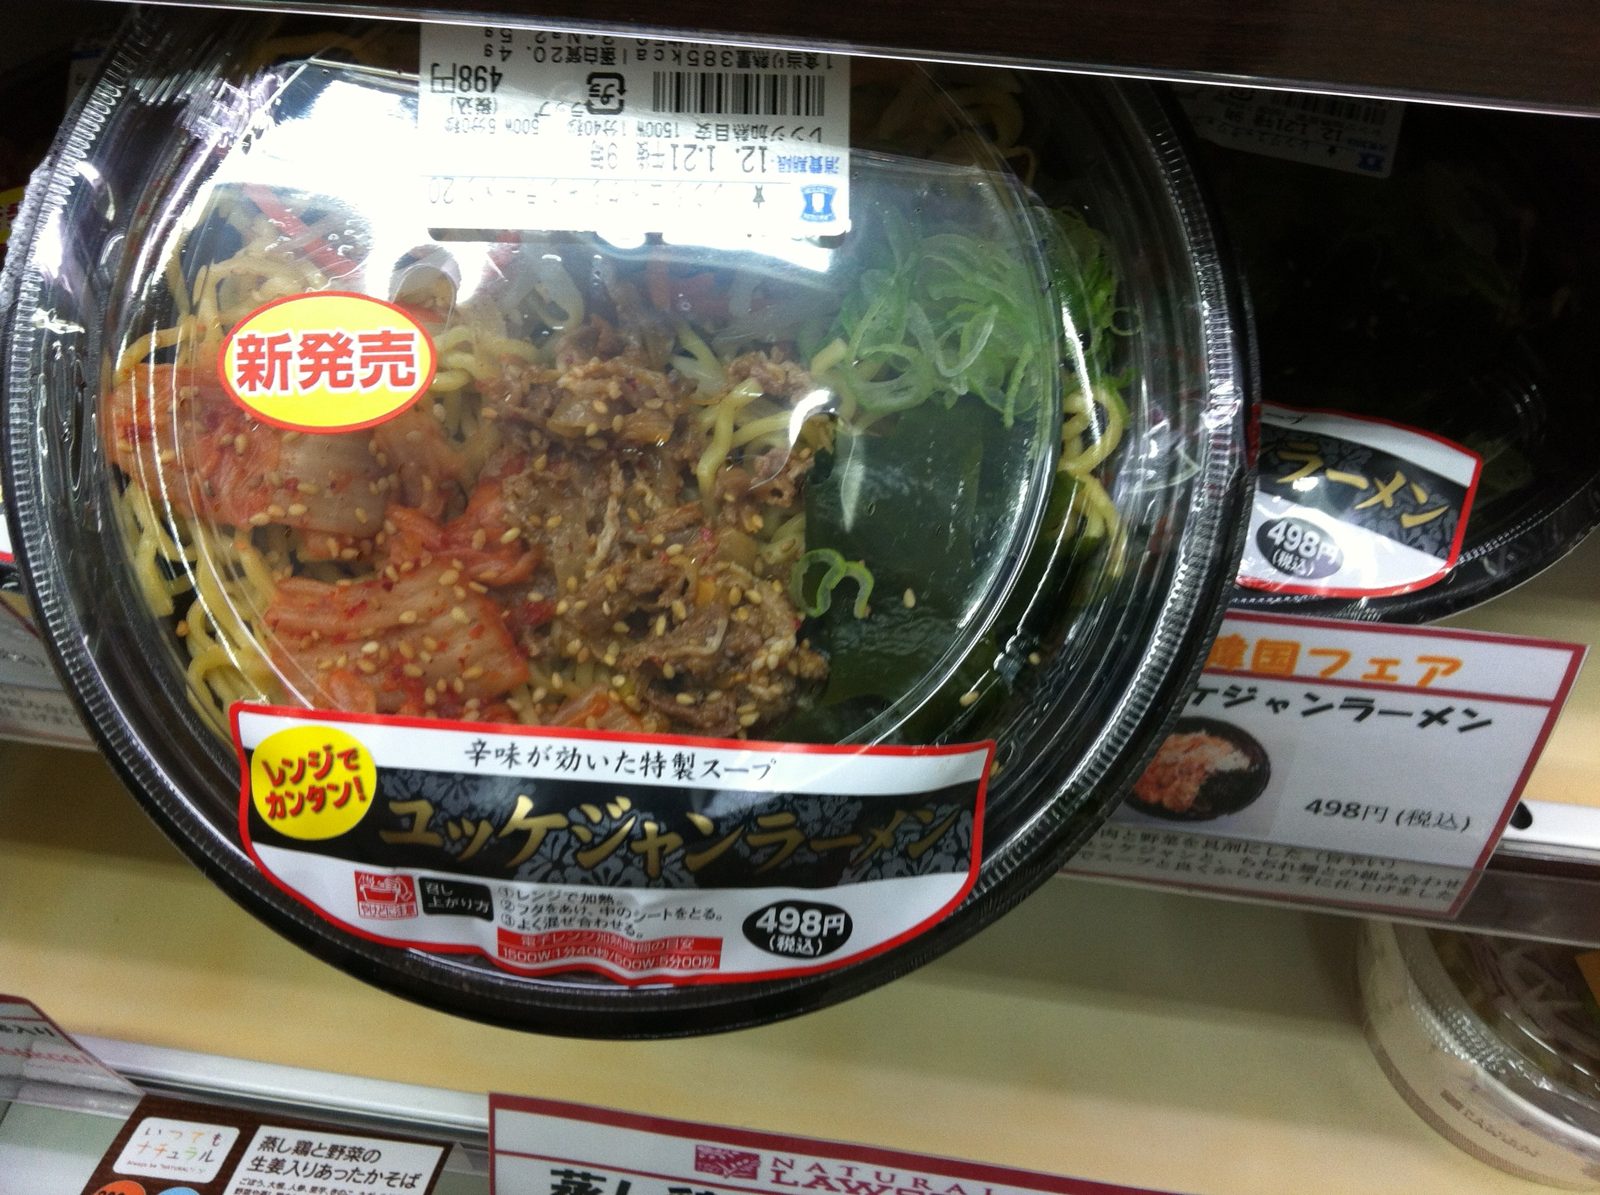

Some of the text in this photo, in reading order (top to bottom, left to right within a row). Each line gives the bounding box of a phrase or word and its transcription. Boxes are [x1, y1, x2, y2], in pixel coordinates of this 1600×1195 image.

[431, 62, 503, 93] 498円
[695, 121, 822, 143] レンジ加熱目安
[777, 154, 840, 175] 消費期限
[236, 329, 417, 392] 新発売
[1275, 441, 1449, 529] ラーメン
[261, 745, 360, 787] レンジで
[464, 738, 777, 782] 辛味が効いた特製スープ
[378, 795, 960, 879] ユッケジャンラーメン
[755, 907, 846, 938] 498円
[768, 937, 823, 954] (税込)
[136, 1140, 215, 1163] ナチュラル
[257, 1135, 382, 1165] 蒸し鶏と野菜の
[246, 1155, 423, 1190] 生姜入りあったかそば
